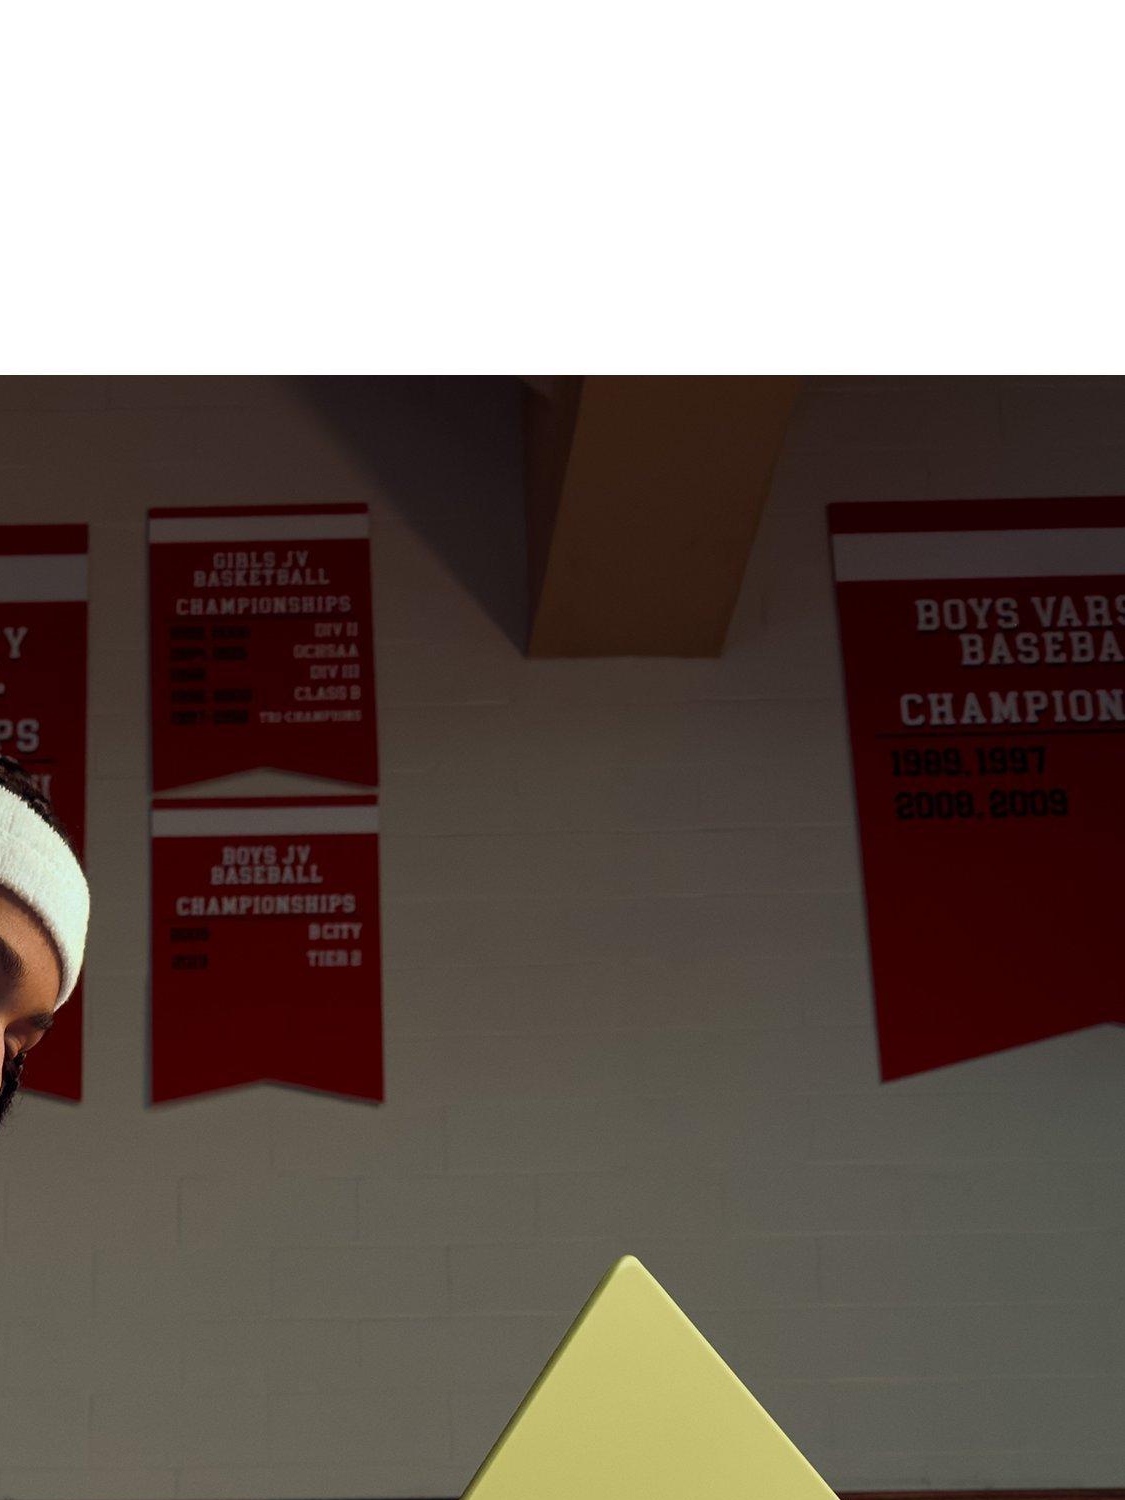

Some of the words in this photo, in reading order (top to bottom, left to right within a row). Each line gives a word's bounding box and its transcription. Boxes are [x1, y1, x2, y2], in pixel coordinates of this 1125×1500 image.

[213, 551, 276, 569] GIRLS
[281, 550, 309, 568] JV
[193, 568, 330, 587] BASKETBALL
[176, 596, 352, 616] CHAMPIONSHIPS
[914, 597, 1021, 632] BOYS
[293, 685, 347, 701] CLASS
[899, 688, 1125, 726] CHAMPION
[976, 745, 1046, 776] 1997
[989, 788, 1068, 818] 2009
[221, 845, 277, 866] BOYS
[281, 844, 312, 864] JV
[210, 863, 324, 885] BASEBALL
[175, 894, 356, 917] CHAMPIONSHIPS
